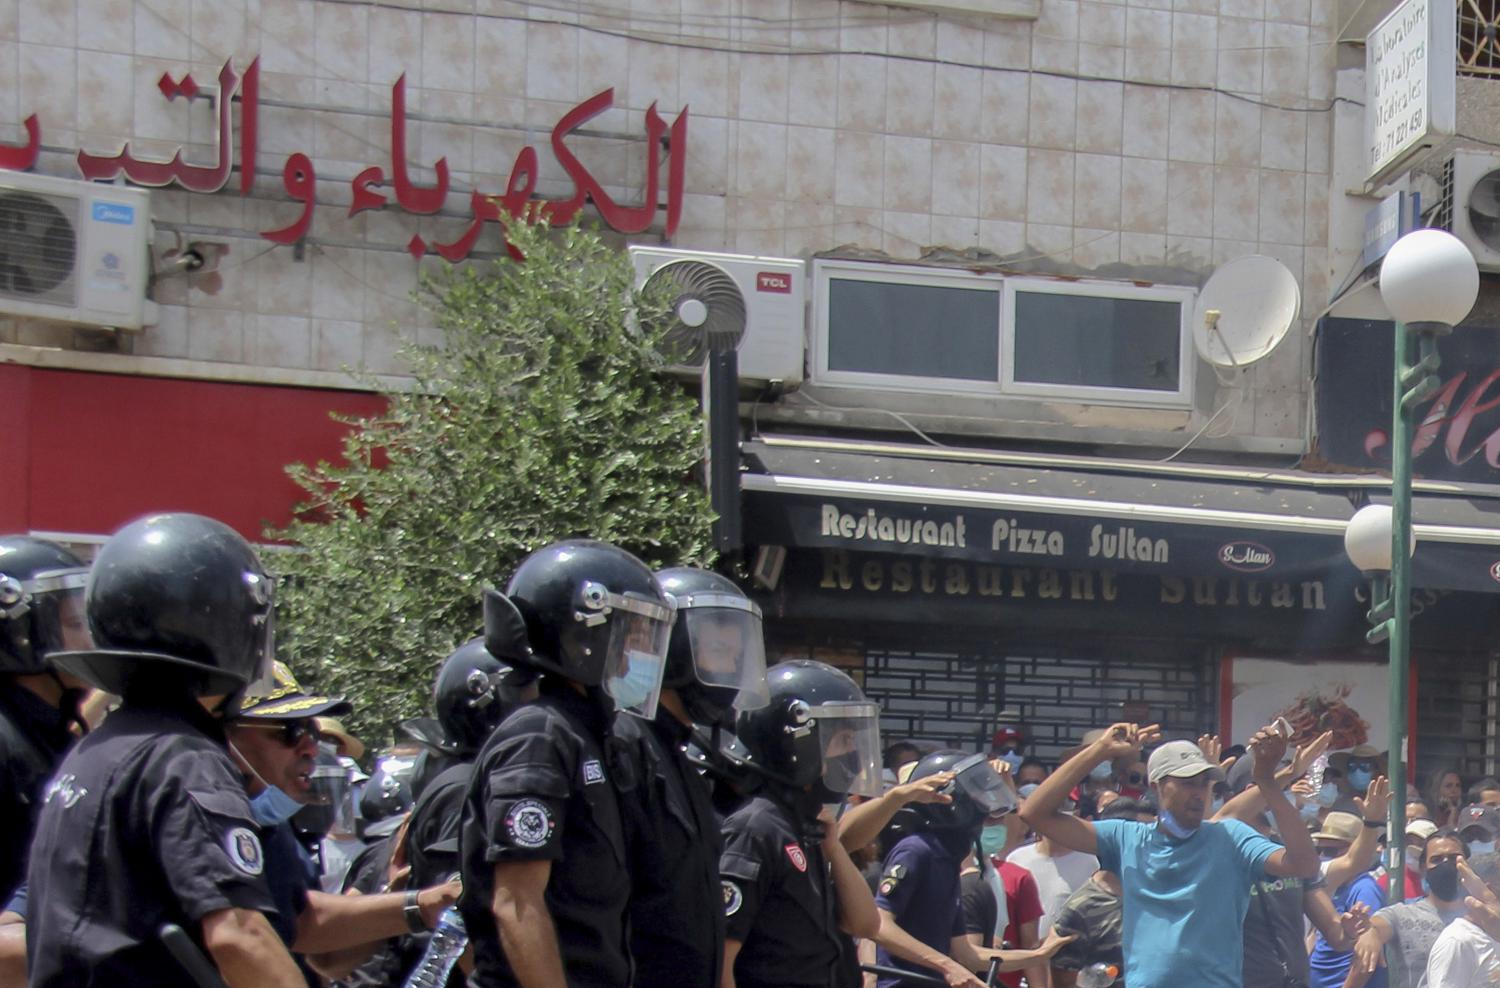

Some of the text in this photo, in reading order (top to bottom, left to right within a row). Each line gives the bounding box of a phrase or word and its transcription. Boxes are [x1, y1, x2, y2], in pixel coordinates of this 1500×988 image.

[1387, 130, 1396, 153] 71
[1396, 119, 1408, 146] 221
[1409, 107, 1423, 132] 450
[348, 71, 689, 262] الكهرباء
[761, 277, 788, 288] TCL
[821, 503, 1170, 563] Restaurant Pizza Sultan
[820, 551, 1119, 602] Restaurant
